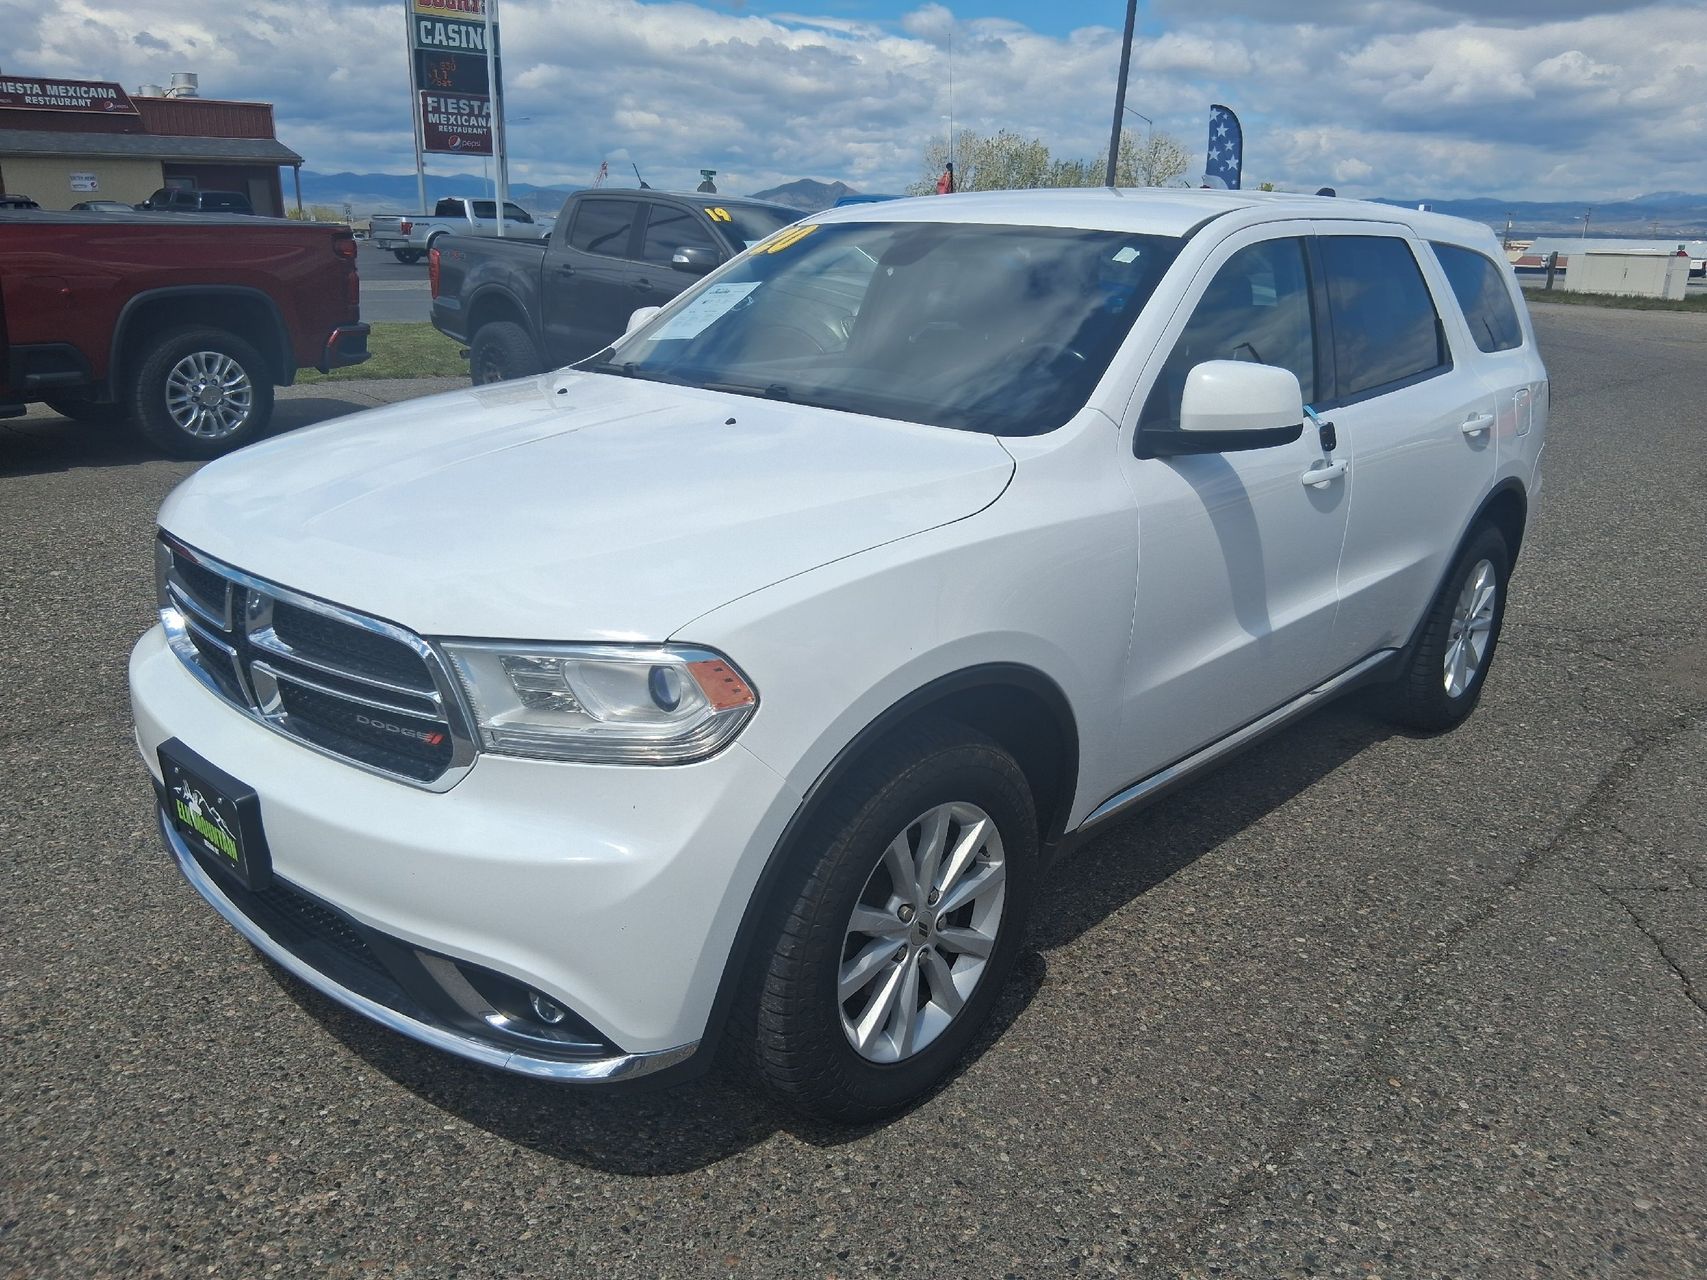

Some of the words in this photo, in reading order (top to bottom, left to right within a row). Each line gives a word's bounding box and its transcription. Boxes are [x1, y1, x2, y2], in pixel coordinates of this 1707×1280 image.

[0, 82, 42, 95] IESTA
[46, 84, 117, 98] MEXICANA
[25, 96, 92, 107] RESTAURANT
[439, 125, 487, 135] RESTAURANT
[704, 207, 732, 222] 19
[356, 714, 432, 742] DODGE
